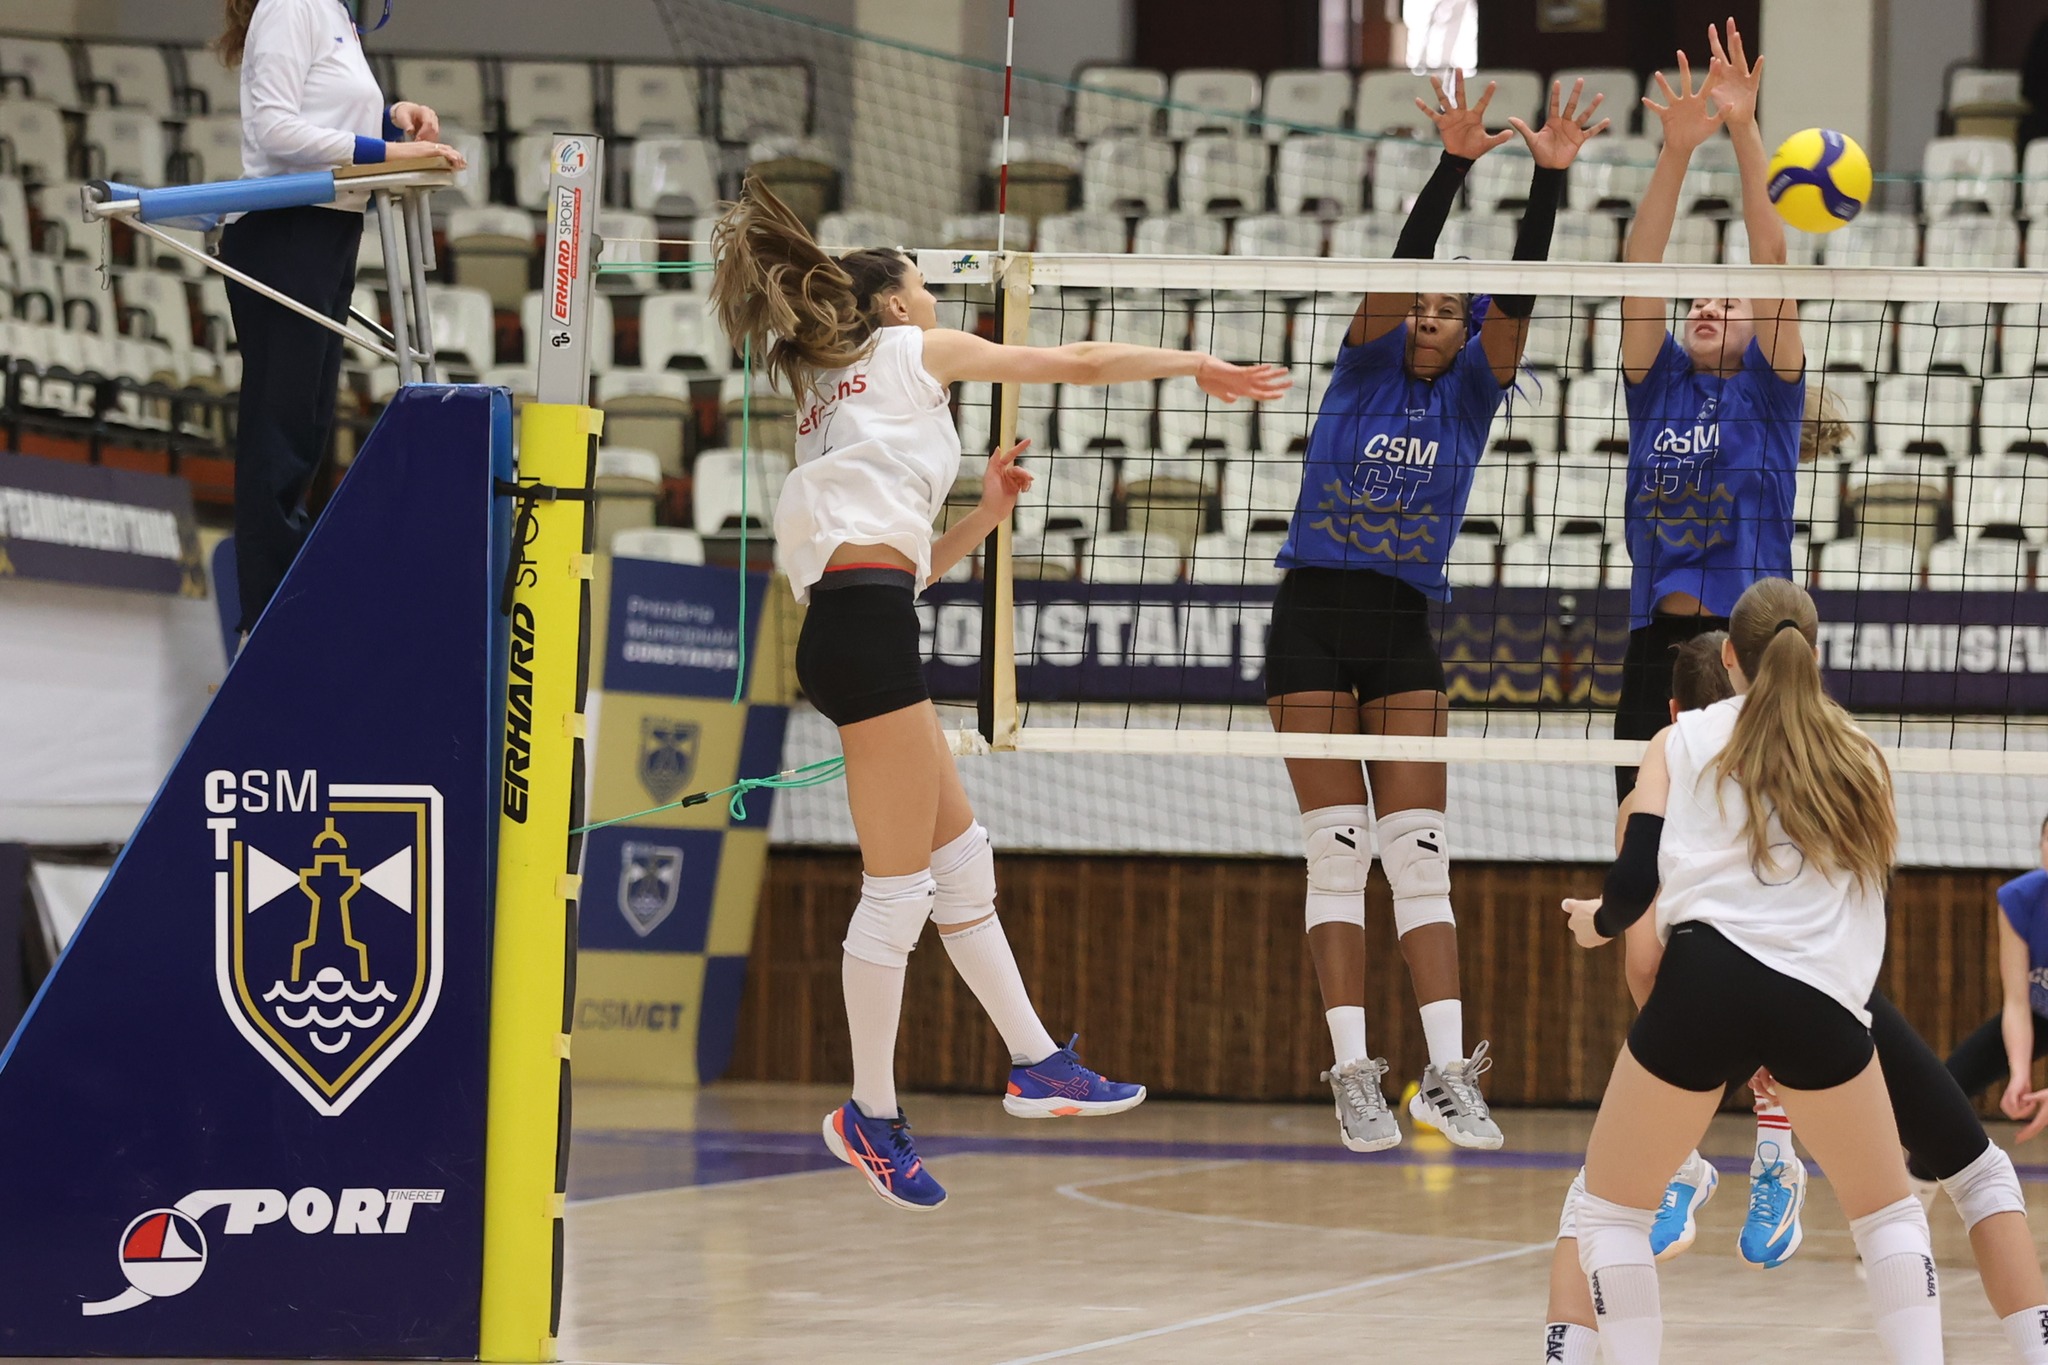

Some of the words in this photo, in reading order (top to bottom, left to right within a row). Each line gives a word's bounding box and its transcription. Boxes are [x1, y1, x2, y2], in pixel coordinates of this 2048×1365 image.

[577, 153, 584, 168] 1
[560, 193, 574, 235] SPORT
[555, 239, 571, 319] ERHARD
[551, 332, 571, 348] GS
[1363, 433, 1440, 466] CSM
[1349, 459, 1433, 510] CT
[503, 602, 536, 825] ERHARD
[205, 769, 317, 814] CSM
[206, 817, 237, 860] T
[390, 1190, 443, 1201] TINERET
